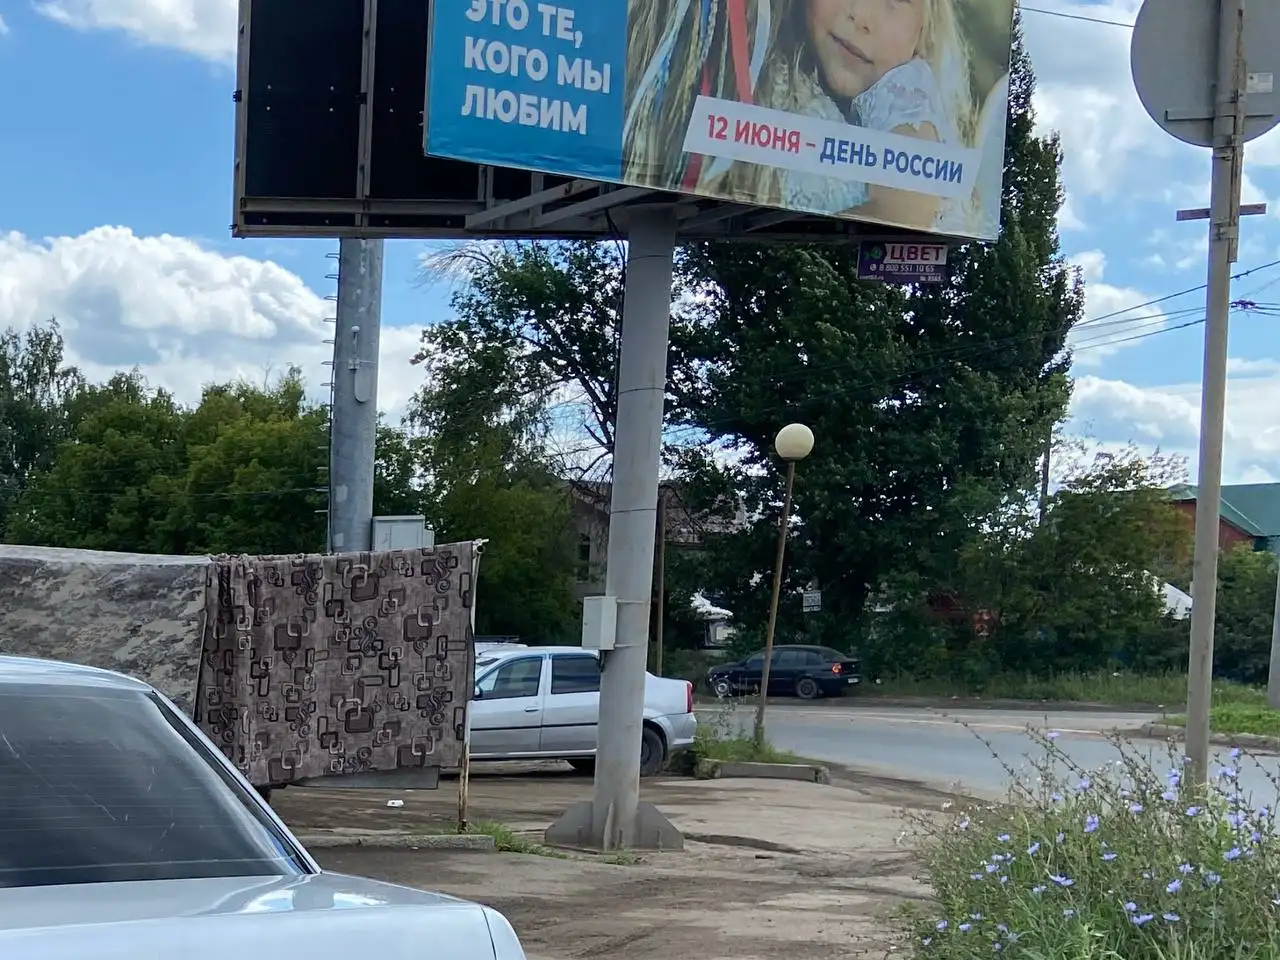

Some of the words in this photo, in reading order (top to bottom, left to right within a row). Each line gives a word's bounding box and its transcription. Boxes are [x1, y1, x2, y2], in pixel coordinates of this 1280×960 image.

[466, 0, 529, 30] ЭТО
[537, 3, 583, 48] ТЕ,
[464, 36, 548, 81] КОГО
[557, 54, 610, 94] МЫ
[461, 85, 587, 135] ЛЮБИМ
[707, 114, 727, 140] 12
[734, 119, 801, 154] ИЮНЯ
[820, 137, 878, 167] ДЕНЬ
[882, 148, 964, 184] РОССИИ
[890, 245, 944, 262] ЦВЕТ
